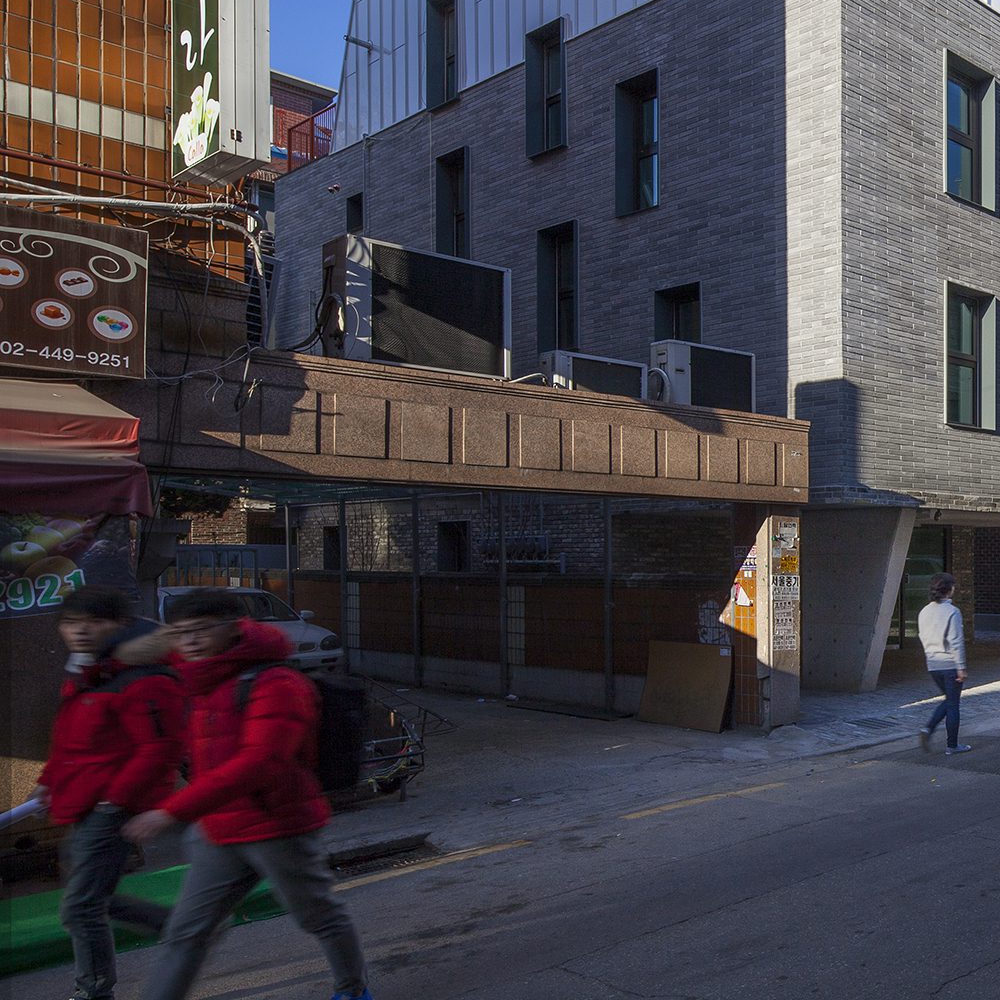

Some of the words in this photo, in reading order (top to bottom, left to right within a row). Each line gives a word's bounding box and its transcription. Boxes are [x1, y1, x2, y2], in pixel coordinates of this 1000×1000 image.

[0, 341, 130, 368] 02-449-9251
[0, 568, 86, 612] 921
[772, 575, 799, 587] 서울중기
